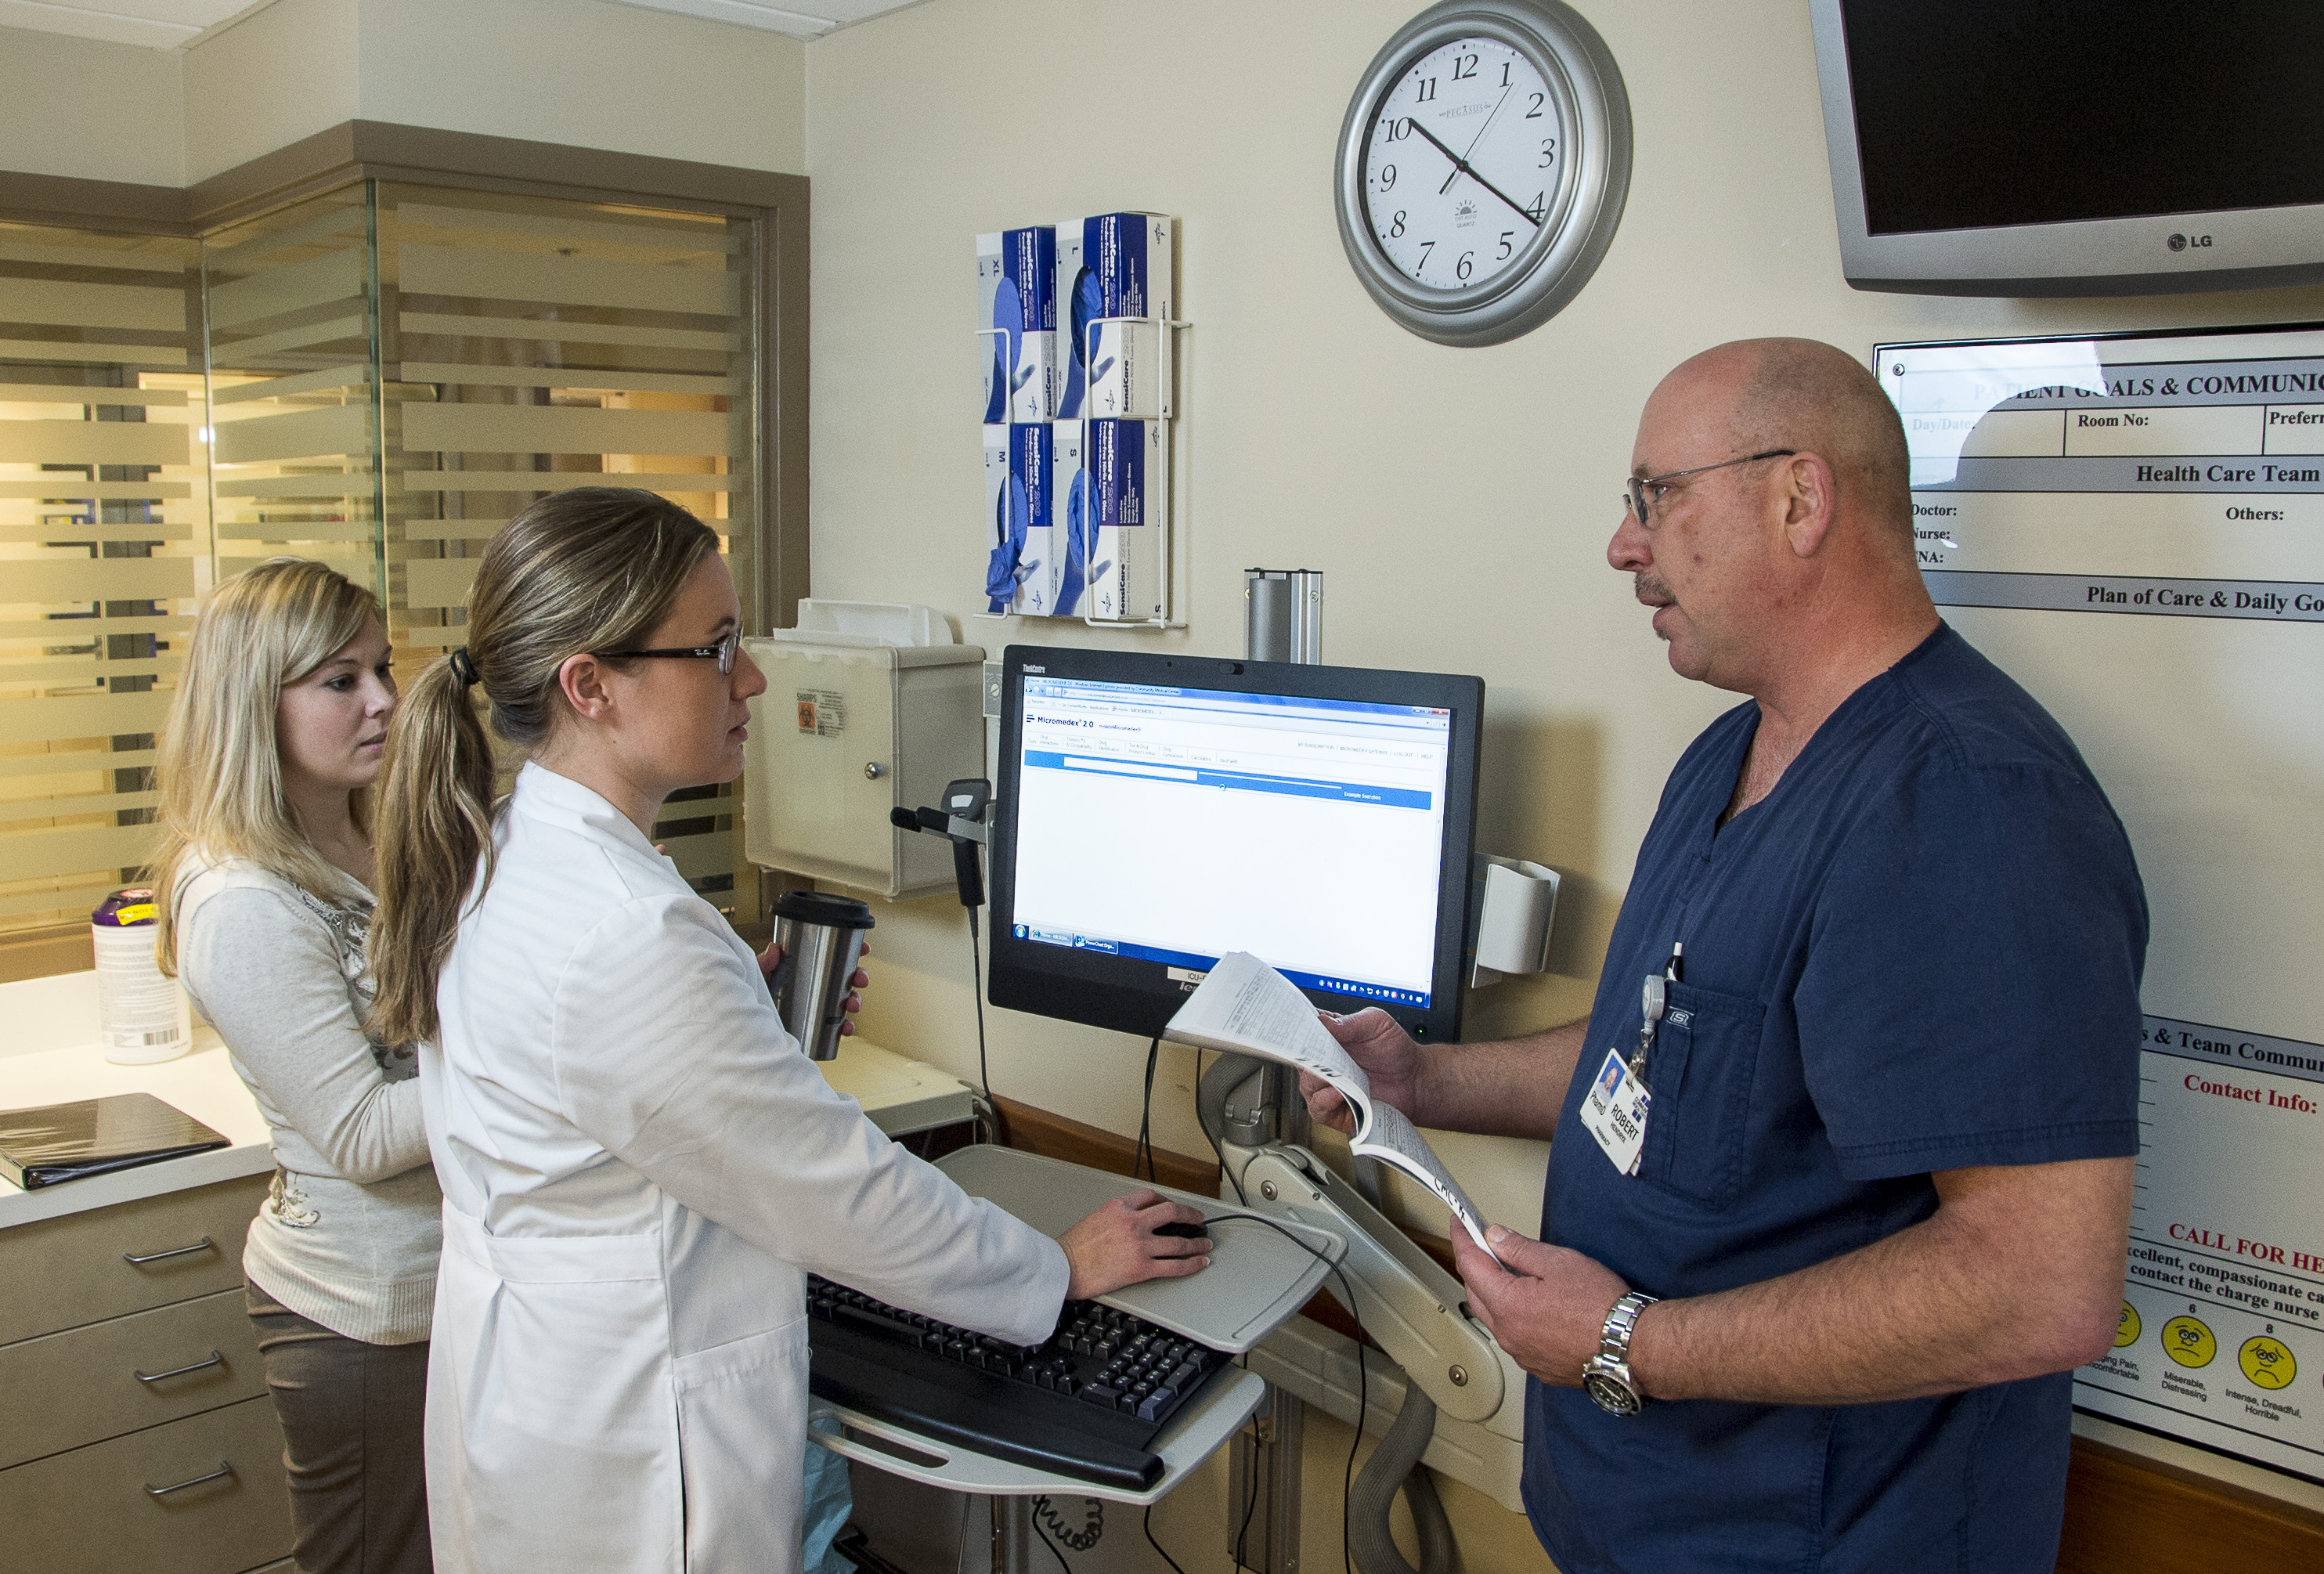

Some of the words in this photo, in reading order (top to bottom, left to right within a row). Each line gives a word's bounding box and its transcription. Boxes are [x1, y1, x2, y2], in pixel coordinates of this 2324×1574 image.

[1451, 53, 1479, 81] 12
[1499, 62, 1510, 88] 1
[1415, 76, 1437, 103] 11
[1525, 92, 1544, 119] 2
[1384, 117, 1412, 143] 10
[1537, 138, 1555, 168] 3
[1380, 164, 1397, 193] 9
[1525, 190, 1545, 220] 4
[1390, 210, 1407, 238] 8
[1496, 231, 1514, 260] 5
[2190, 235, 2212, 247] LG
[993, 259, 1000, 276] XL
[1417, 241, 1435, 270] 7
[1456, 251, 1474, 280] 6
[2160, 376, 2180, 395] &
[2077, 414, 2119, 428] Room
[2123, 413, 2149, 427] No:
[998, 452, 1005, 462] M
[2137, 464, 2200, 482] Health
[2206, 465, 2256, 482] Care
[2261, 465, 2320, 483] Team
[1912, 504, 1957, 516] Doctor:
[2226, 506, 2284, 521] Others:
[1916, 551, 1943, 563] NA:
[2087, 586, 2127, 604] Plan
[2133, 587, 2153, 605] of
[2157, 588, 2204, 607] Care
[2209, 590, 2228, 608] &
[2235, 591, 2290, 614] Daily
[2294, 594, 2324, 612] Go
[2154, 1028, 2171, 1045] &
[2178, 1031, 2232, 1056] Team
[1590, 1091, 1606, 1116] PharmD
[2184, 1074, 2262, 1103] Contact
[2268, 1089, 2318, 1114] Info:
[1610, 1121, 1626, 1144] HENDRYX
[1611, 1103, 1640, 1142] ROBERT
[1595, 1125, 1611, 1147] PHARMACY
[2169, 1223, 2231, 1251] CALL
[2236, 1238, 2286, 1265] FOR
[2292, 1251, 2324, 1274] HE
[2131, 1265, 2185, 1287] contact
[2188, 1277, 2212, 1293] the
[2216, 1284, 2269, 1309] charge
[2273, 1300, 2319, 1321] nurse
[2189, 1262, 2303, 1298] compassionate
[2307, 1290, 2324, 1305] ca
[2189, 1304, 2196, 1313] 6
[2265, 1323, 2274, 1334] 8
[2119, 1358, 2139, 1371] Pain,
[2161, 1380, 2207, 1402] Distressing
[2164, 1371, 2207, 1391] Miserable,
[2225, 1388, 2260, 1406] Intense,
[2261, 1399, 2302, 1418] Dreadful,
[2245, 1404, 2280, 1421] Horrible
